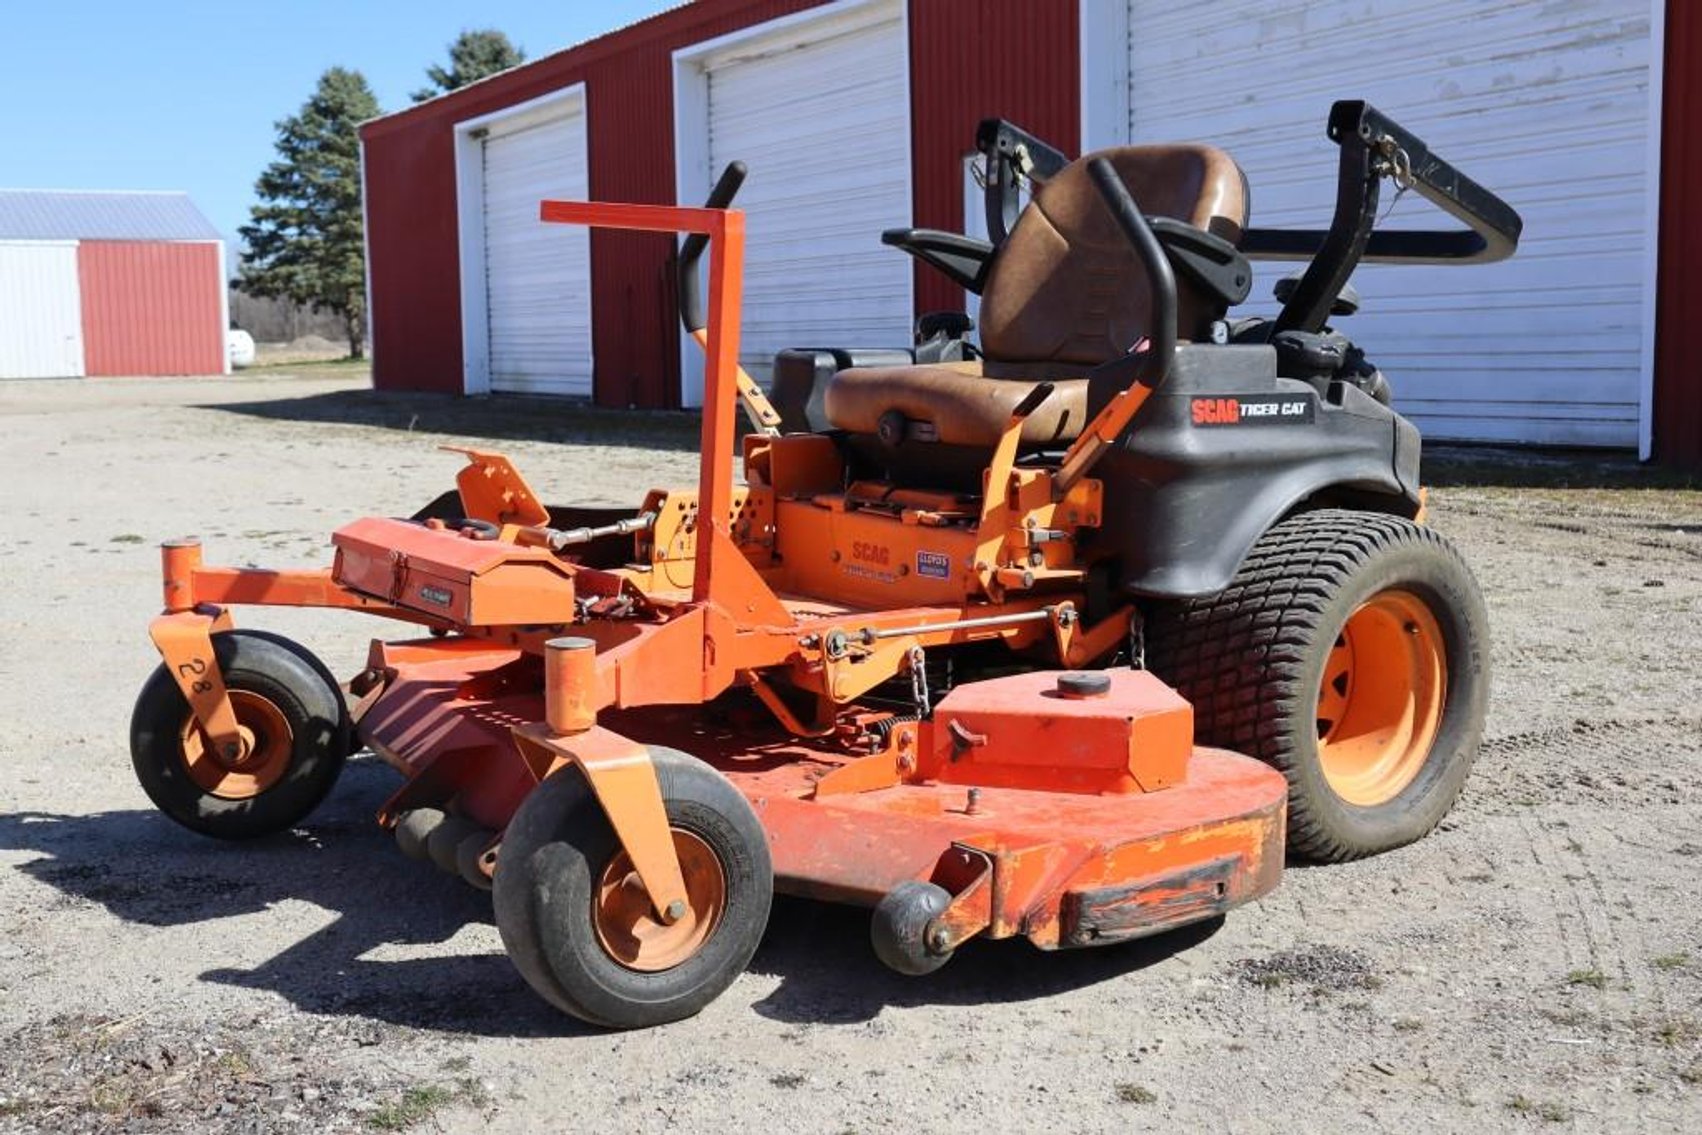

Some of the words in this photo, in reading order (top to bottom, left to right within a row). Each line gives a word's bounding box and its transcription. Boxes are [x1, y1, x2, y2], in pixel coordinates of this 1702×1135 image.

[1191, 399, 1239, 424] SCAG
[1240, 403, 1279, 416] TIGER
[1281, 402, 1306, 415] CAT
[853, 542, 889, 565] SCAG
[178, 658, 213, 694] 28
